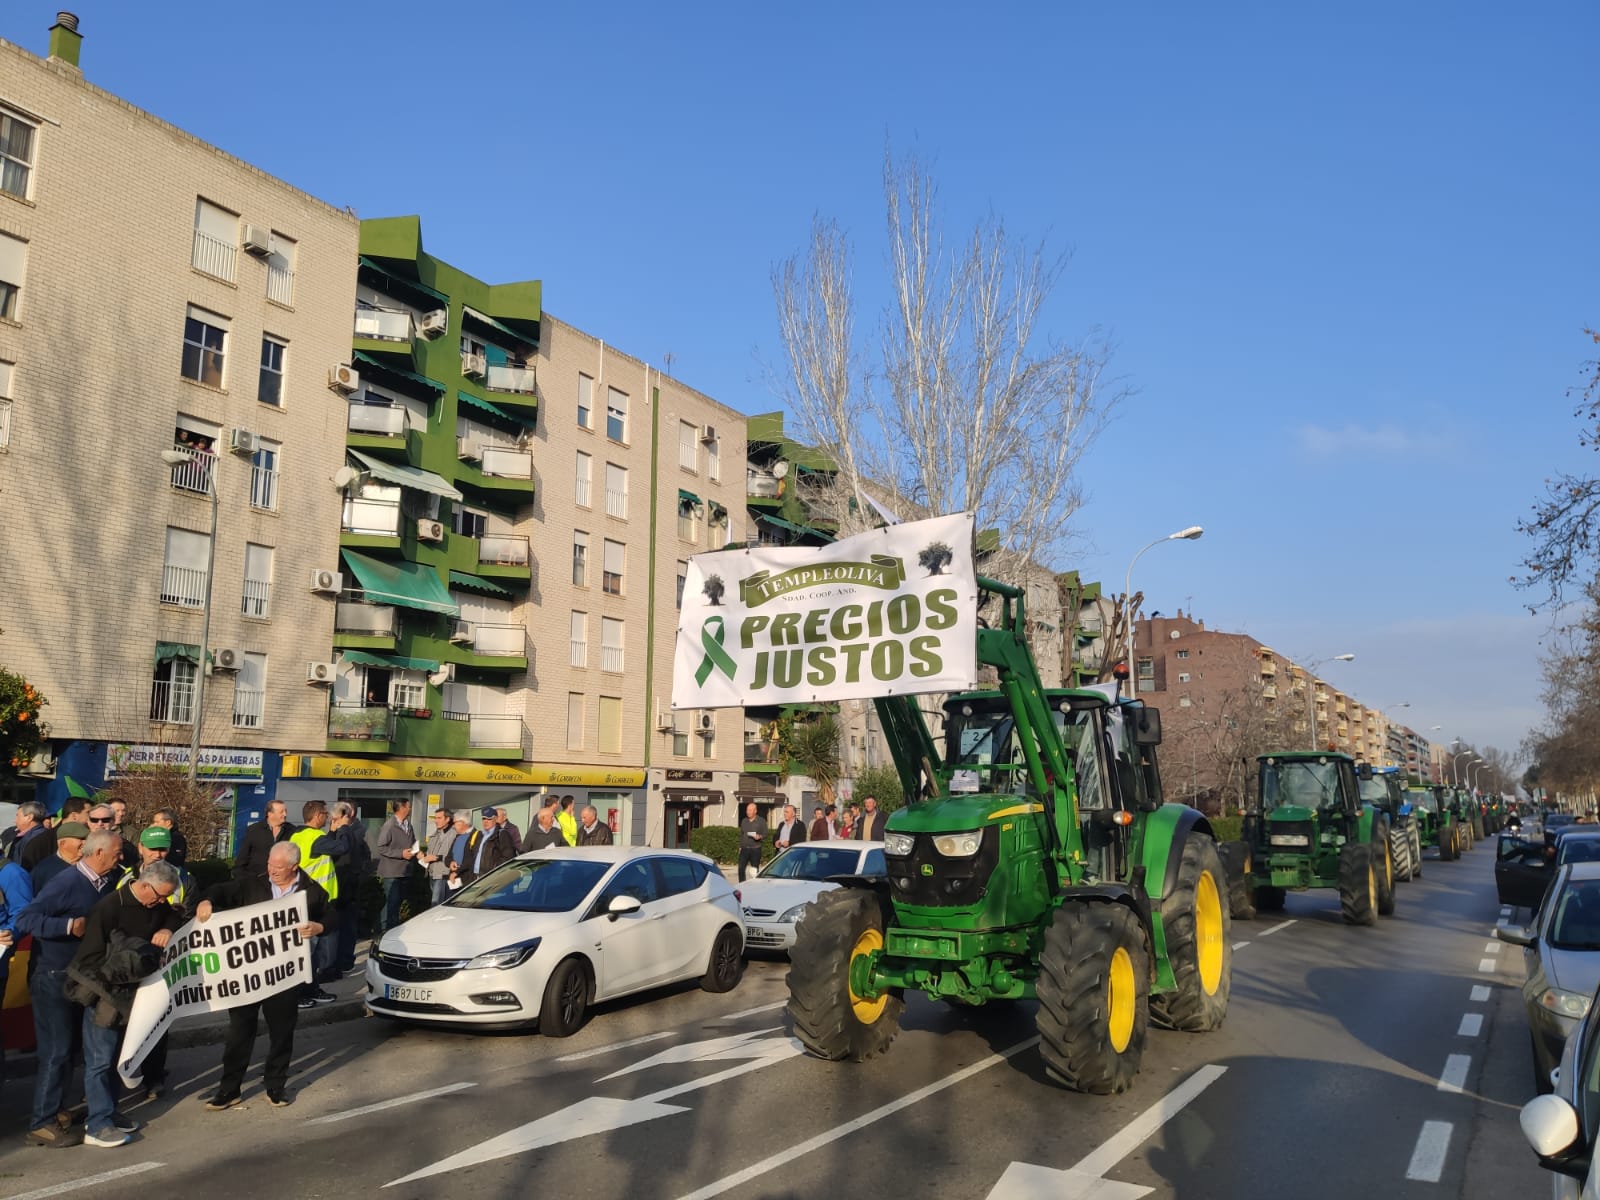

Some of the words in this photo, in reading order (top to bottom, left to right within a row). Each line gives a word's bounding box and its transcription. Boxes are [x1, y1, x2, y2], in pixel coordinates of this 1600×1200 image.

[757, 566, 885, 598] TEMPLEOLIVA
[740, 588, 958, 649] PRECIOS
[749, 635, 943, 690] JUSTOS
[211, 754, 260, 766] PALMERAS
[343, 765, 381, 777] CORREOS
[424, 768, 457, 779] CORREOS
[494, 771, 524, 781] CORREOS
[556, 773, 582, 783] CORREOS
[219, 920, 246, 945] DE
[250, 906, 301, 936] ALHA
[226, 934, 275, 970] CON
[174, 983, 213, 1007] vivir
[217, 978, 241, 998] de
[243, 973, 261, 993] lo
[264, 960, 295, 986] que
[414, 989, 433, 1001] LCF
